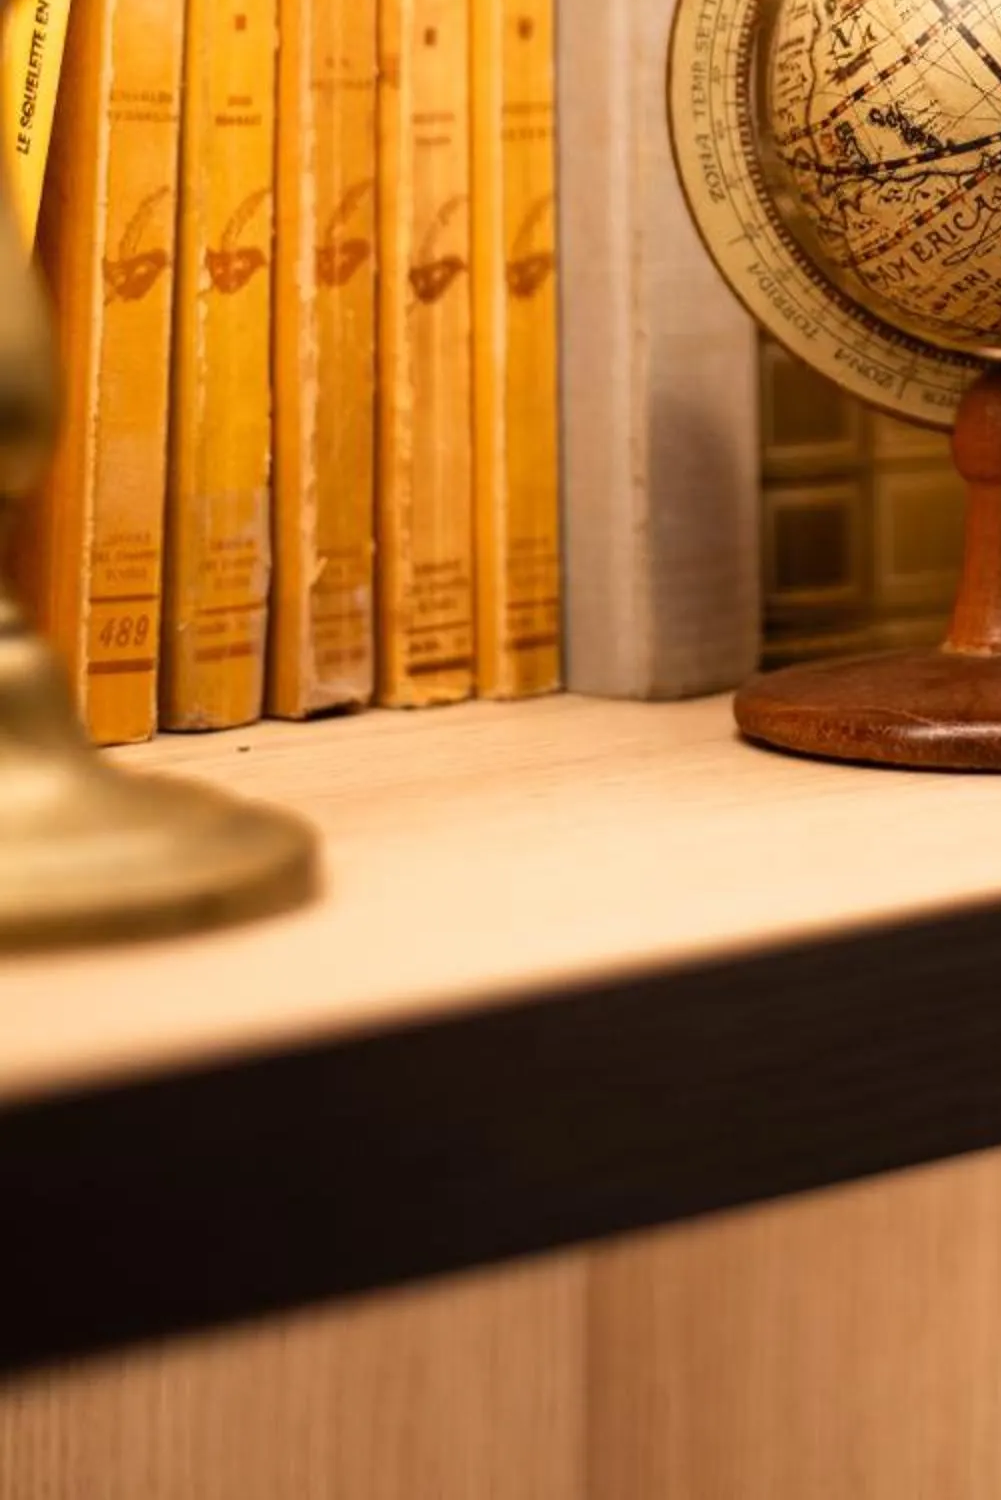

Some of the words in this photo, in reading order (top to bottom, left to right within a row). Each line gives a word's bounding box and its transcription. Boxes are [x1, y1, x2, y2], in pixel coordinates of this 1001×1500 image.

[35, 0, 49, 24] EN
[19, 27, 46, 130] SQUELETTE
[16, 131, 31, 156] LE
[100, 614, 149, 647] 489
